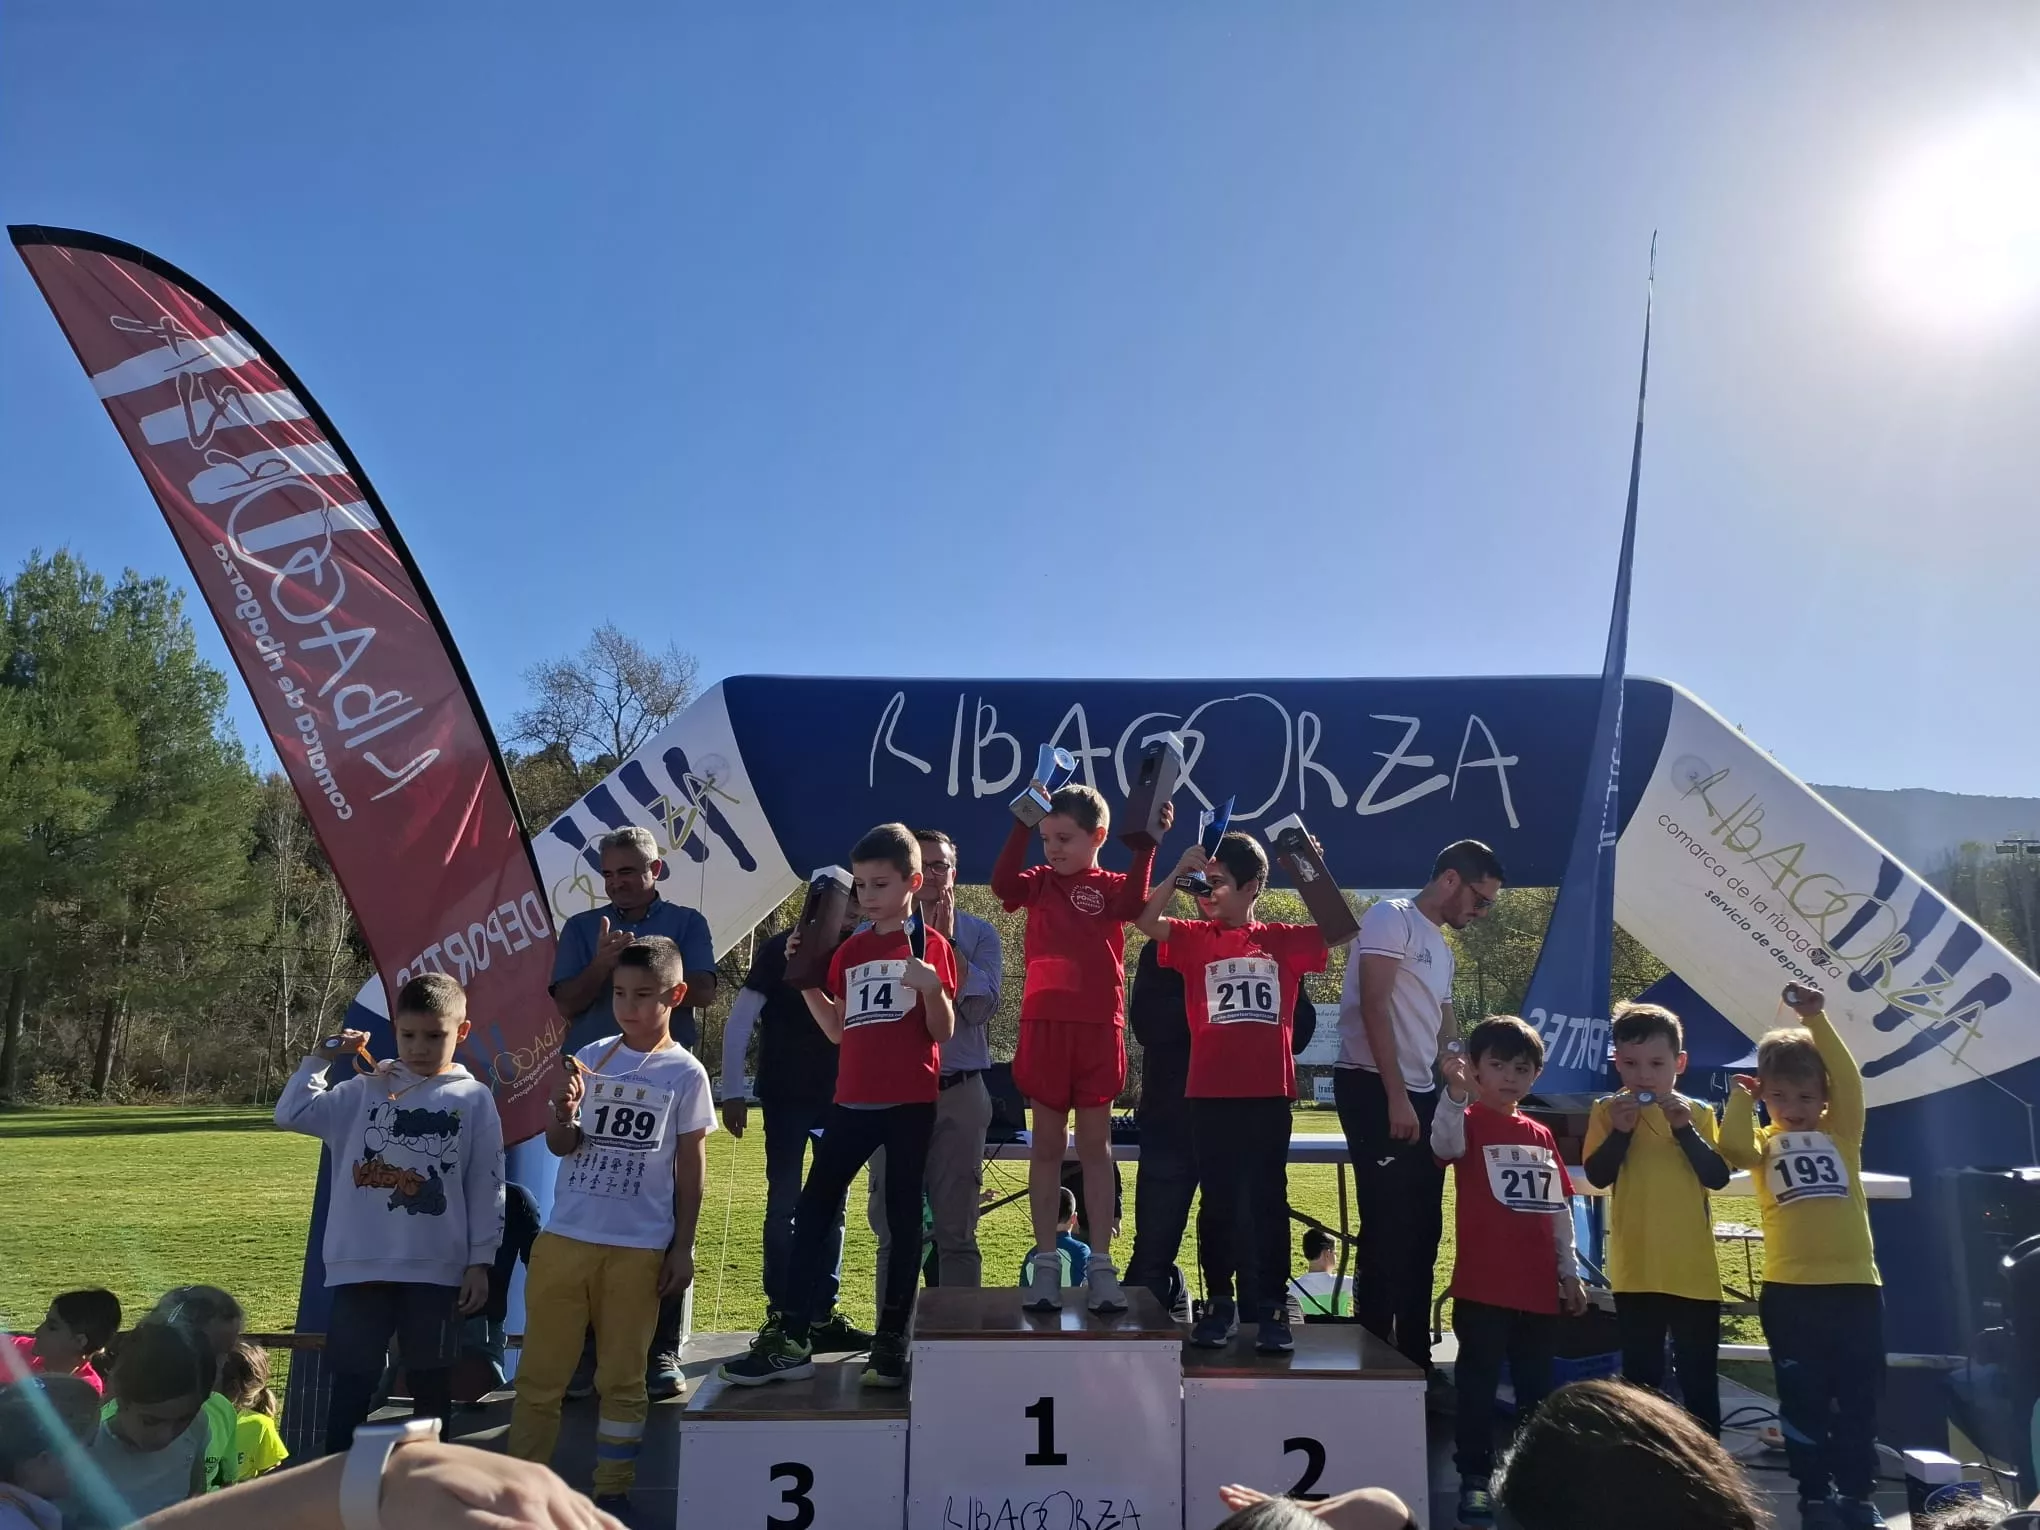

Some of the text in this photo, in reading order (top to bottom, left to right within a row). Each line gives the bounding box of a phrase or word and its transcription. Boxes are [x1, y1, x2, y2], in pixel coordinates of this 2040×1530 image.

[869, 690, 1520, 829] RIBAGORZA
[1657, 814, 1843, 979] comarca de la ribagorza
[1680, 767, 1985, 1066] RIBAGORZA
[1704, 889, 1751, 931] servicio
[1751, 931, 1770, 947] de
[859, 982, 893, 1011] 14
[1216, 980, 1272, 1011] 216
[594, 1105, 656, 1140] 189
[1501, 1169, 1552, 1200] 217
[1774, 1155, 1840, 1188] 193
[1024, 1396, 1068, 1466] 1
[766, 1461, 815, 1530] 3
[1283, 1436, 1330, 1501] 2
[942, 1490, 1141, 1530] RIBAGORZA
